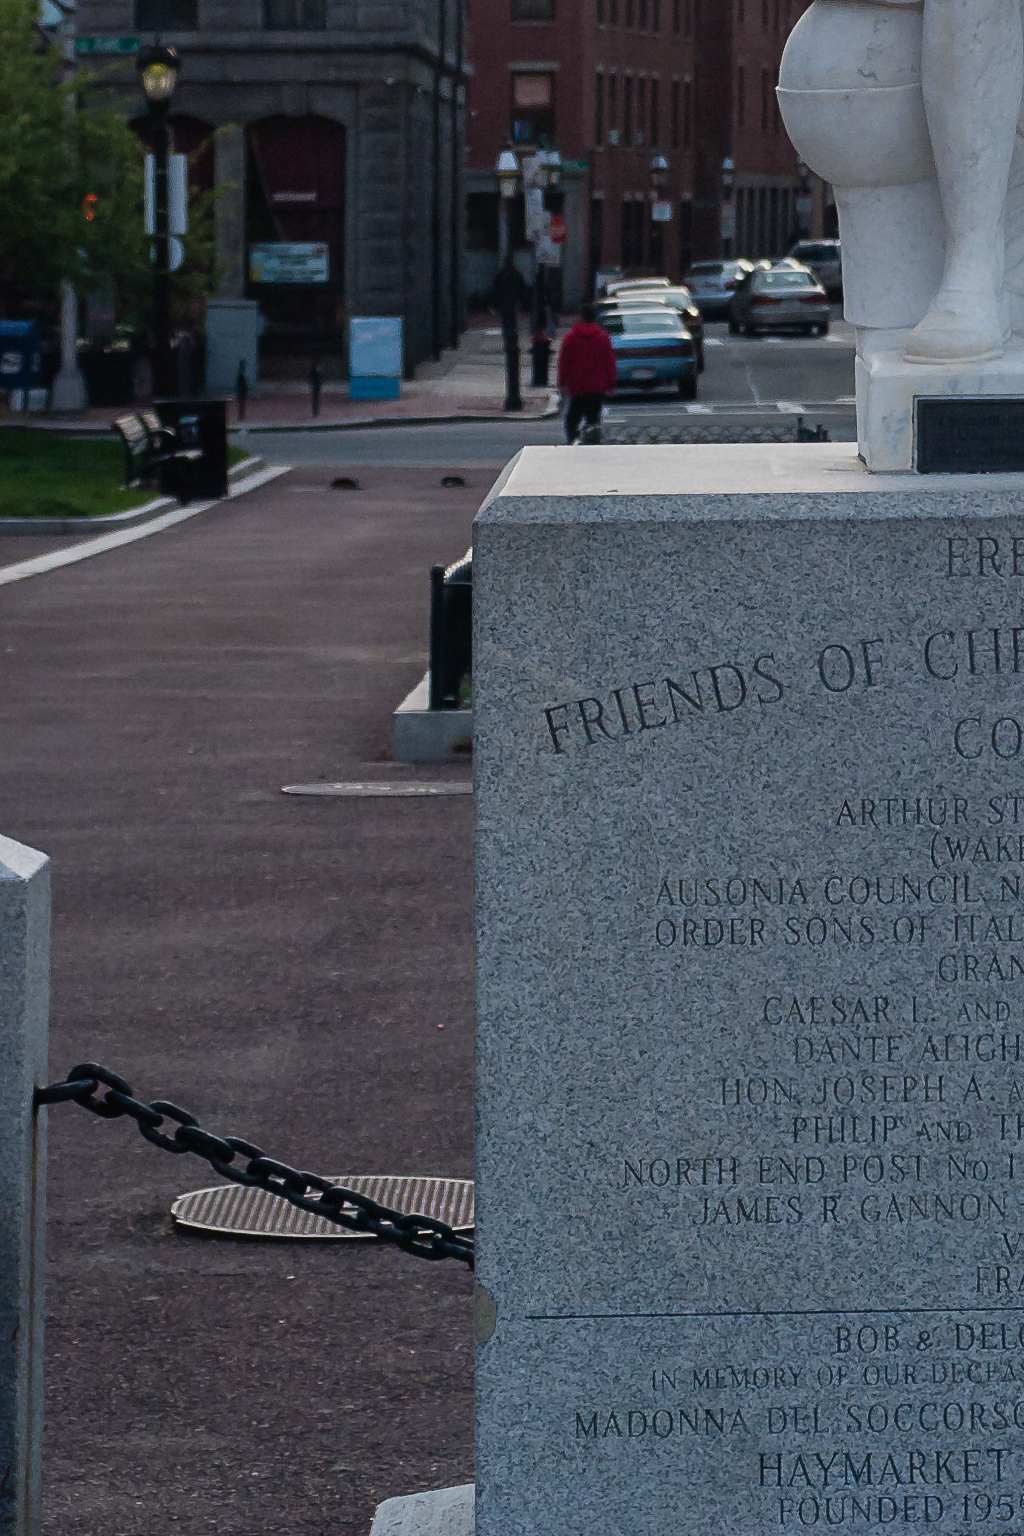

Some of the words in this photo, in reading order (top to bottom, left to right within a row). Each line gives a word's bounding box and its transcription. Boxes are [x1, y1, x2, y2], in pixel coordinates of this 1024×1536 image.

[544, 653, 784, 755] FRIENDS
[818, 639, 884, 693] OF
[836, 796, 968, 827] ARTHUR
[656, 876, 809, 907] AUSONIA
[656, 917, 765, 948] ORDER
[784, 916, 876, 947] SONS
[893, 915, 928, 944] OF
[763, 996, 890, 1026] CAESAR
[957, 1002, 1011, 1024] AND
[794, 1036, 900, 1064] DANTE
[812, 1075, 946, 1106] JOSEPH
[793, 1116, 899, 1145] PHILIP
[916, 1120, 973, 1143] AND
[622, 1157, 739, 1189] NORTH
[758, 1156, 827, 1185] END
[842, 1154, 925, 1184] POST
[692, 1195, 803, 1227] JAMES
[860, 1193, 1008, 1223] GANNON
[835, 1325, 900, 1354] BOB
[915, 1329, 935, 1352] &
[651, 1368, 677, 1391] IN
[692, 1366, 801, 1390] MEMORY
[817, 1364, 849, 1388] OF
[862, 1363, 919, 1386] OUR
[574, 1407, 746, 1440] MADONNA
[767, 1404, 829, 1436] DEL
[757, 1447, 1012, 1488] HAYMARKET
[779, 1494, 945, 1526] FOUNDED
